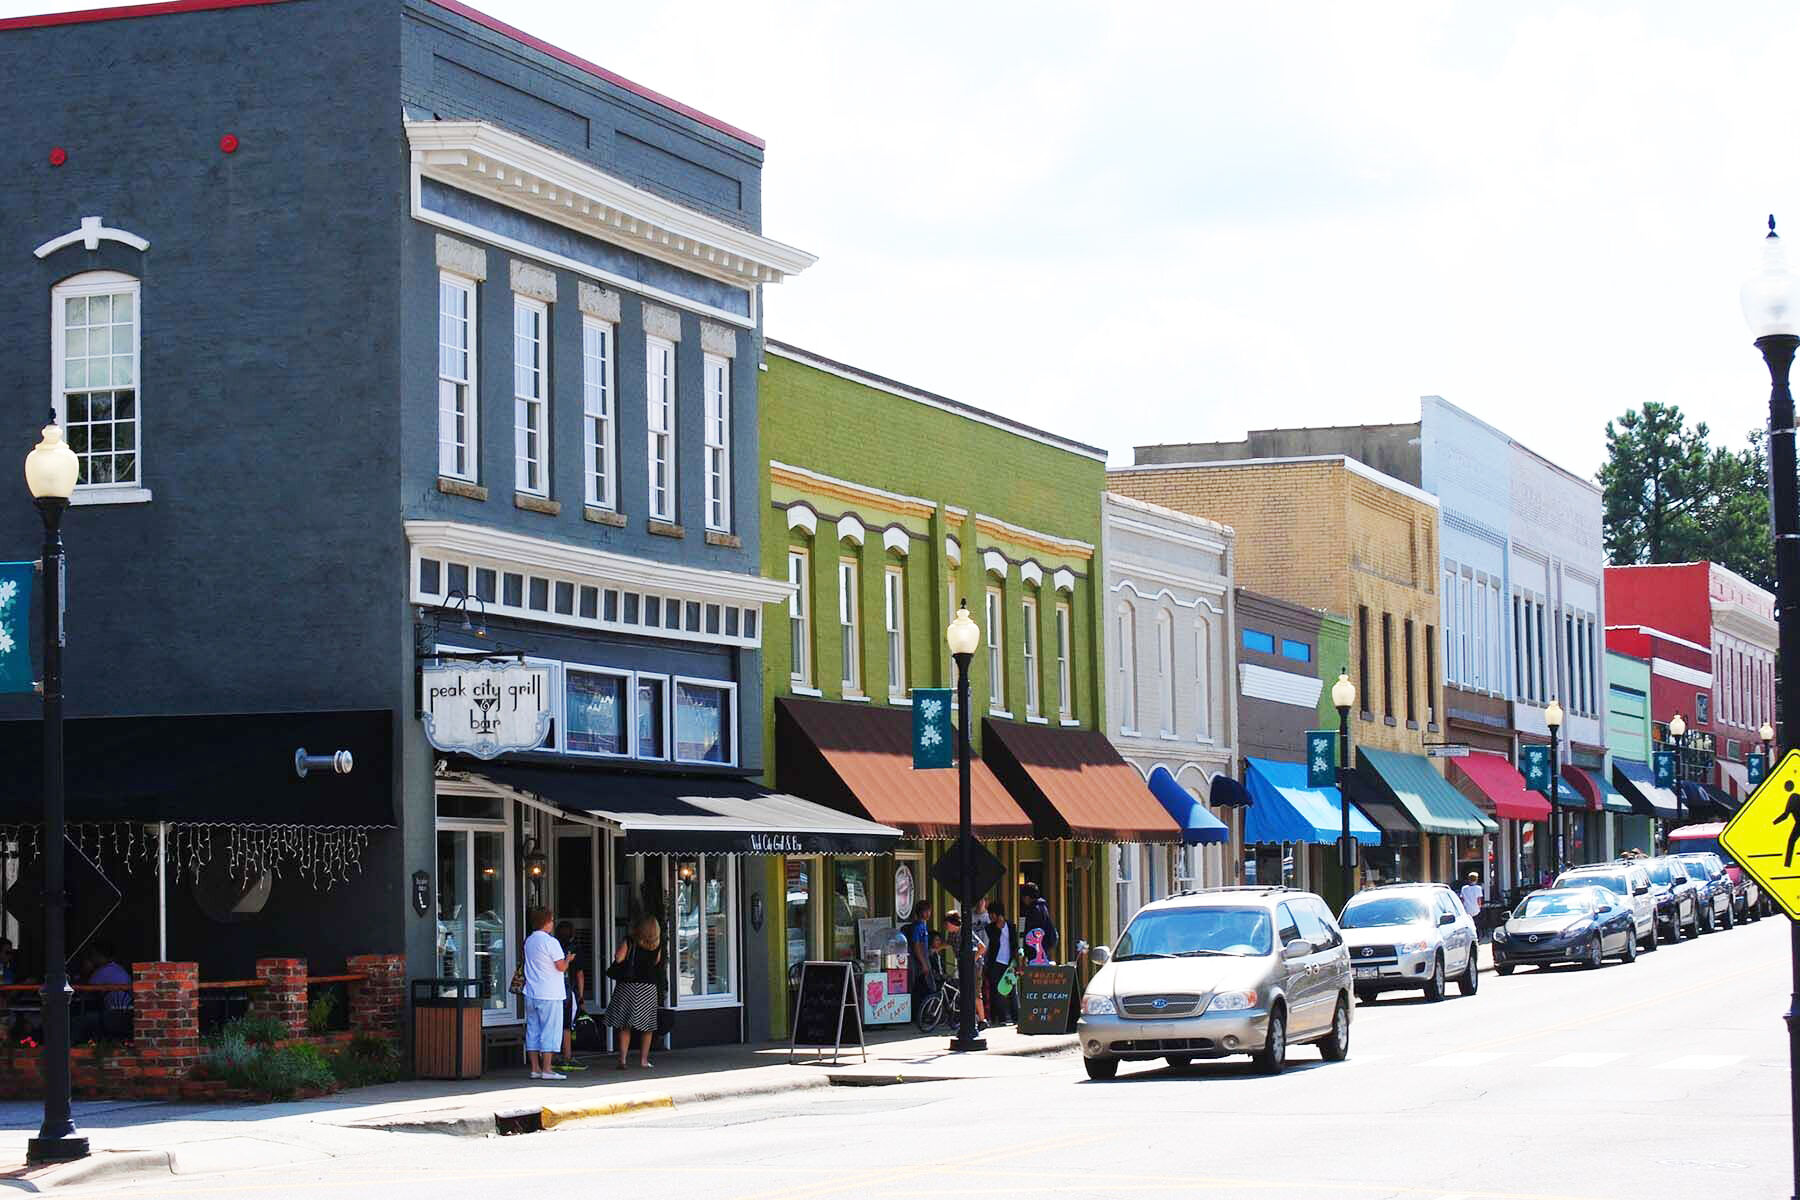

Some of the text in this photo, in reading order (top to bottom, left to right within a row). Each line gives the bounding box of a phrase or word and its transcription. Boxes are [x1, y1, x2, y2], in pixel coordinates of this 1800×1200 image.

[430, 674, 541, 713] peak city grill
[469, 709, 501, 730] bar
[1026, 992, 1068, 1000] ICE CREAM
